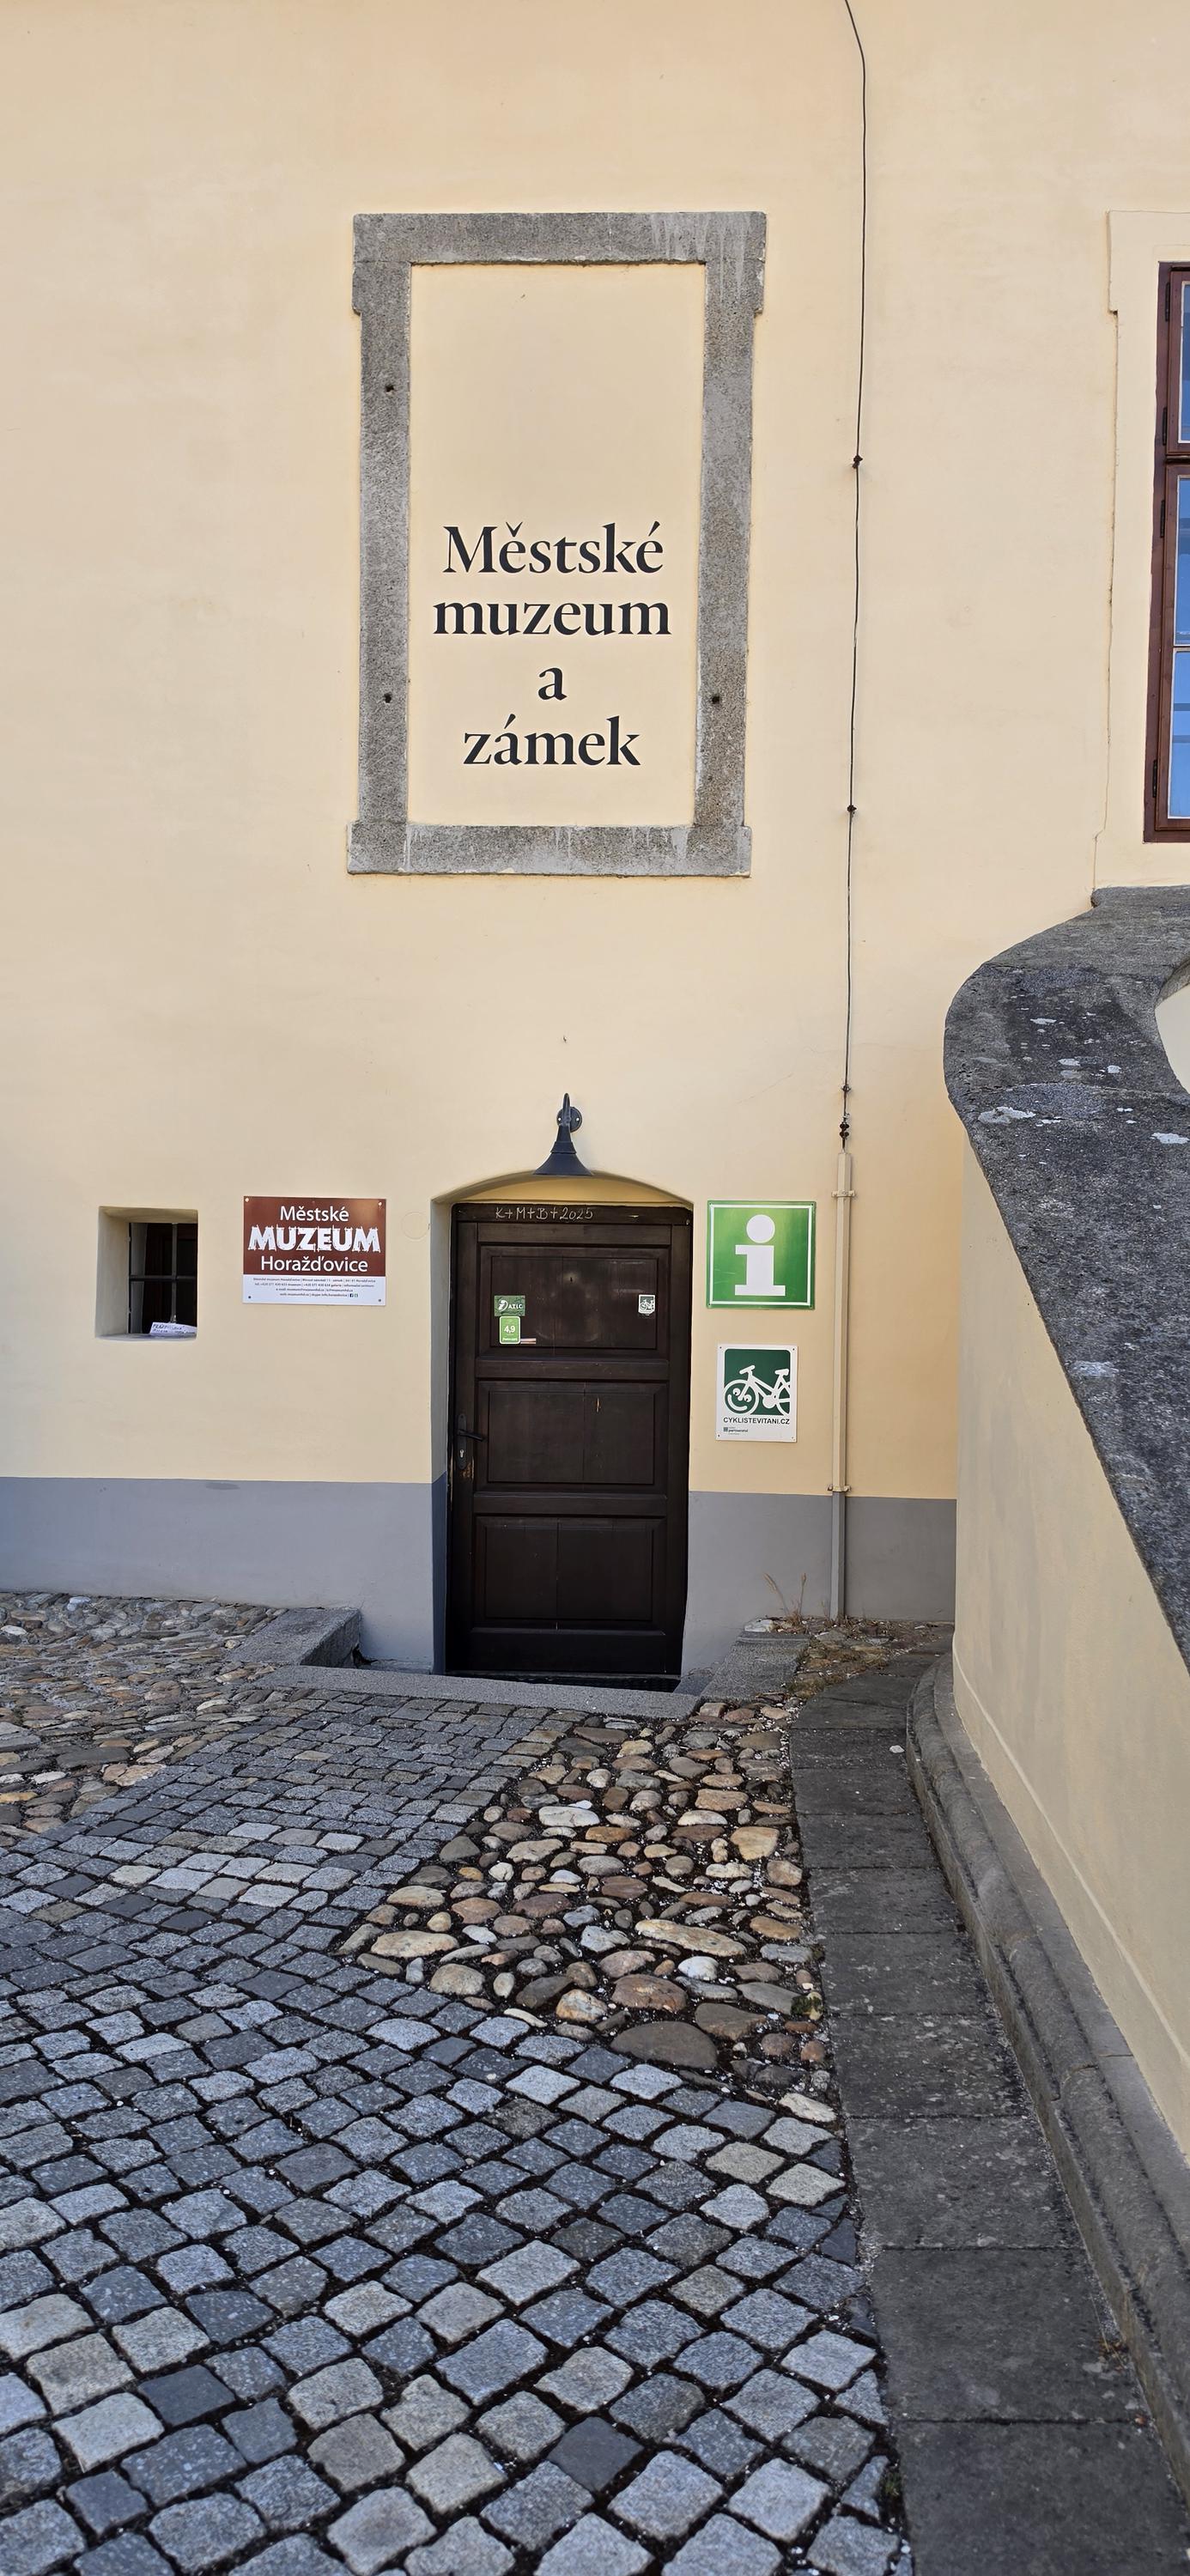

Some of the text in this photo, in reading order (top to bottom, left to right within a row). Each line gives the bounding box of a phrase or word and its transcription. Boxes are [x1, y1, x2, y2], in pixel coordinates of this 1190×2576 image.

[442, 520, 664, 574] Městské
[433, 602, 672, 635] muzeum
[537, 667, 568, 701] a
[463, 714, 641, 766] zámek
[280, 1206, 349, 1221] Městské
[247, 1224, 381, 1253] MUZEUM
[261, 1255, 368, 1273] Horažďovice
[723, 1417, 790, 1425] CYKLISTEVITANI.CZ
